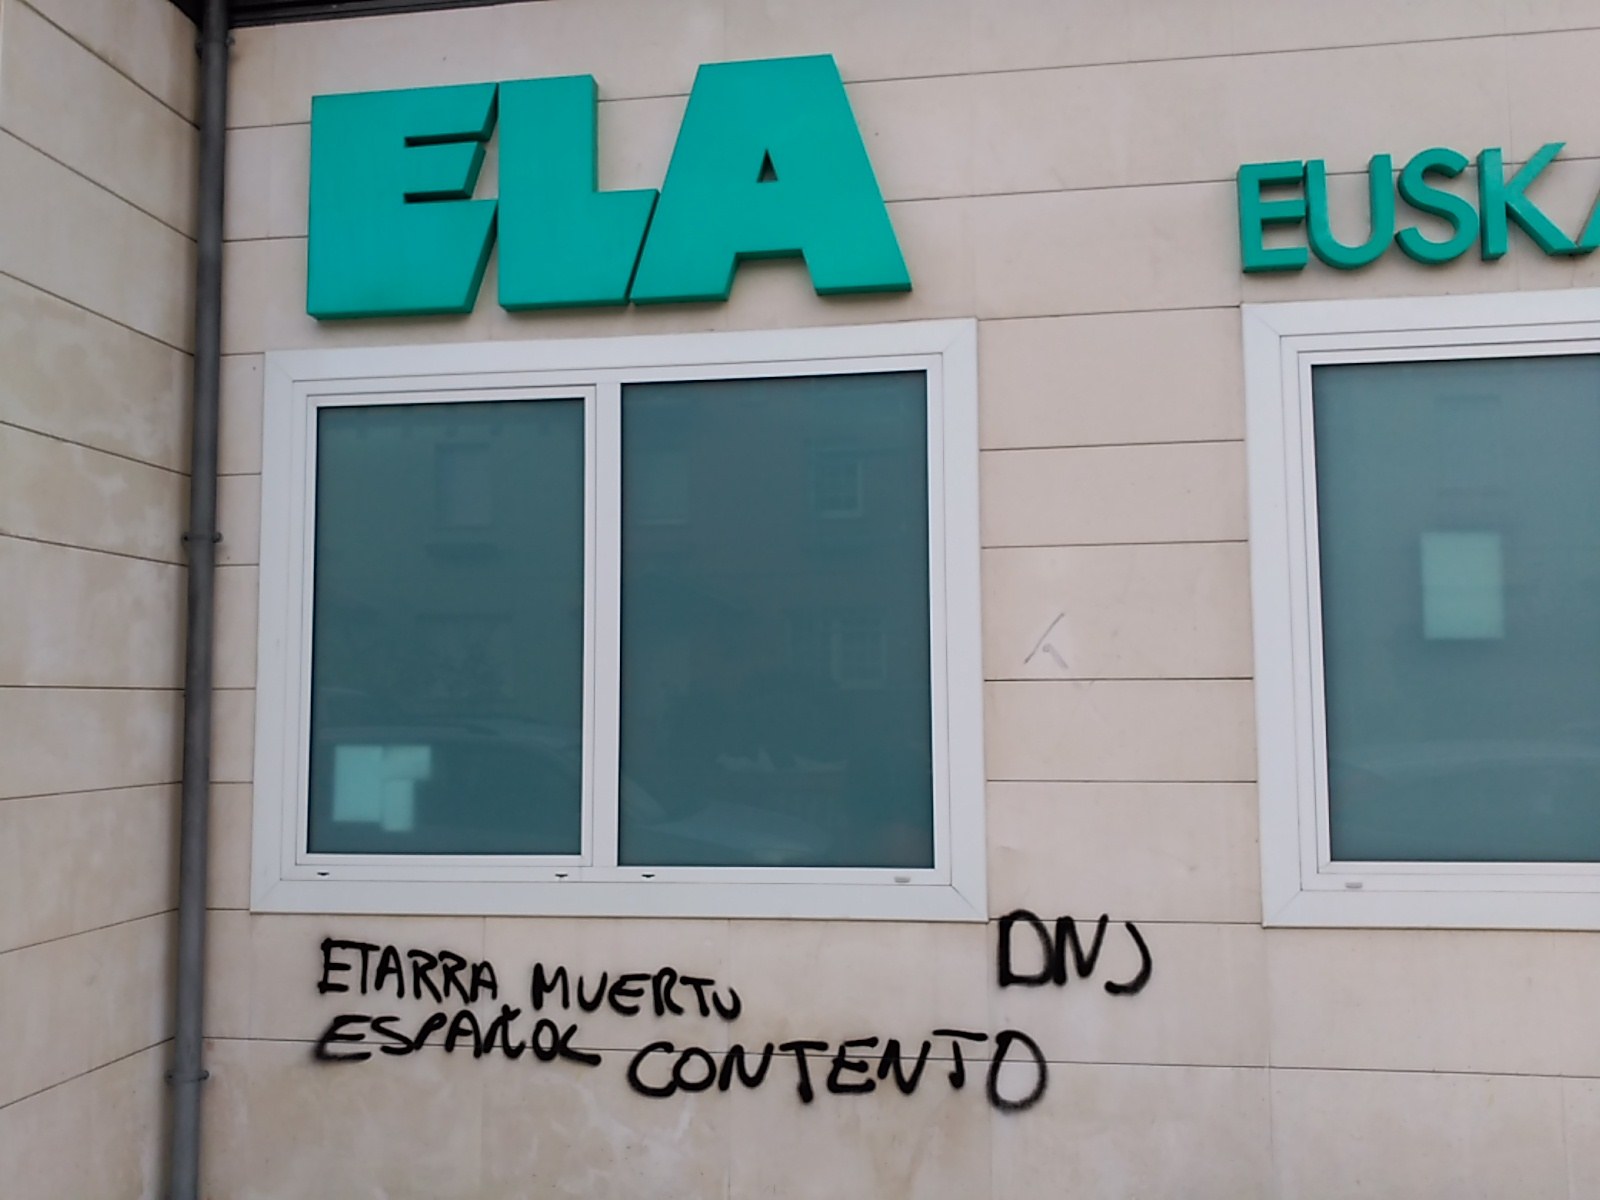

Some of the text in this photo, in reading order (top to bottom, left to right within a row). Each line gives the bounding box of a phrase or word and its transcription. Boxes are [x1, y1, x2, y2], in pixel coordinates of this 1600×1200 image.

[307, 54, 912, 321] ELA
[317, 937, 499, 1005] ETARRA
[627, 1029, 1049, 1114] CONTENTO
